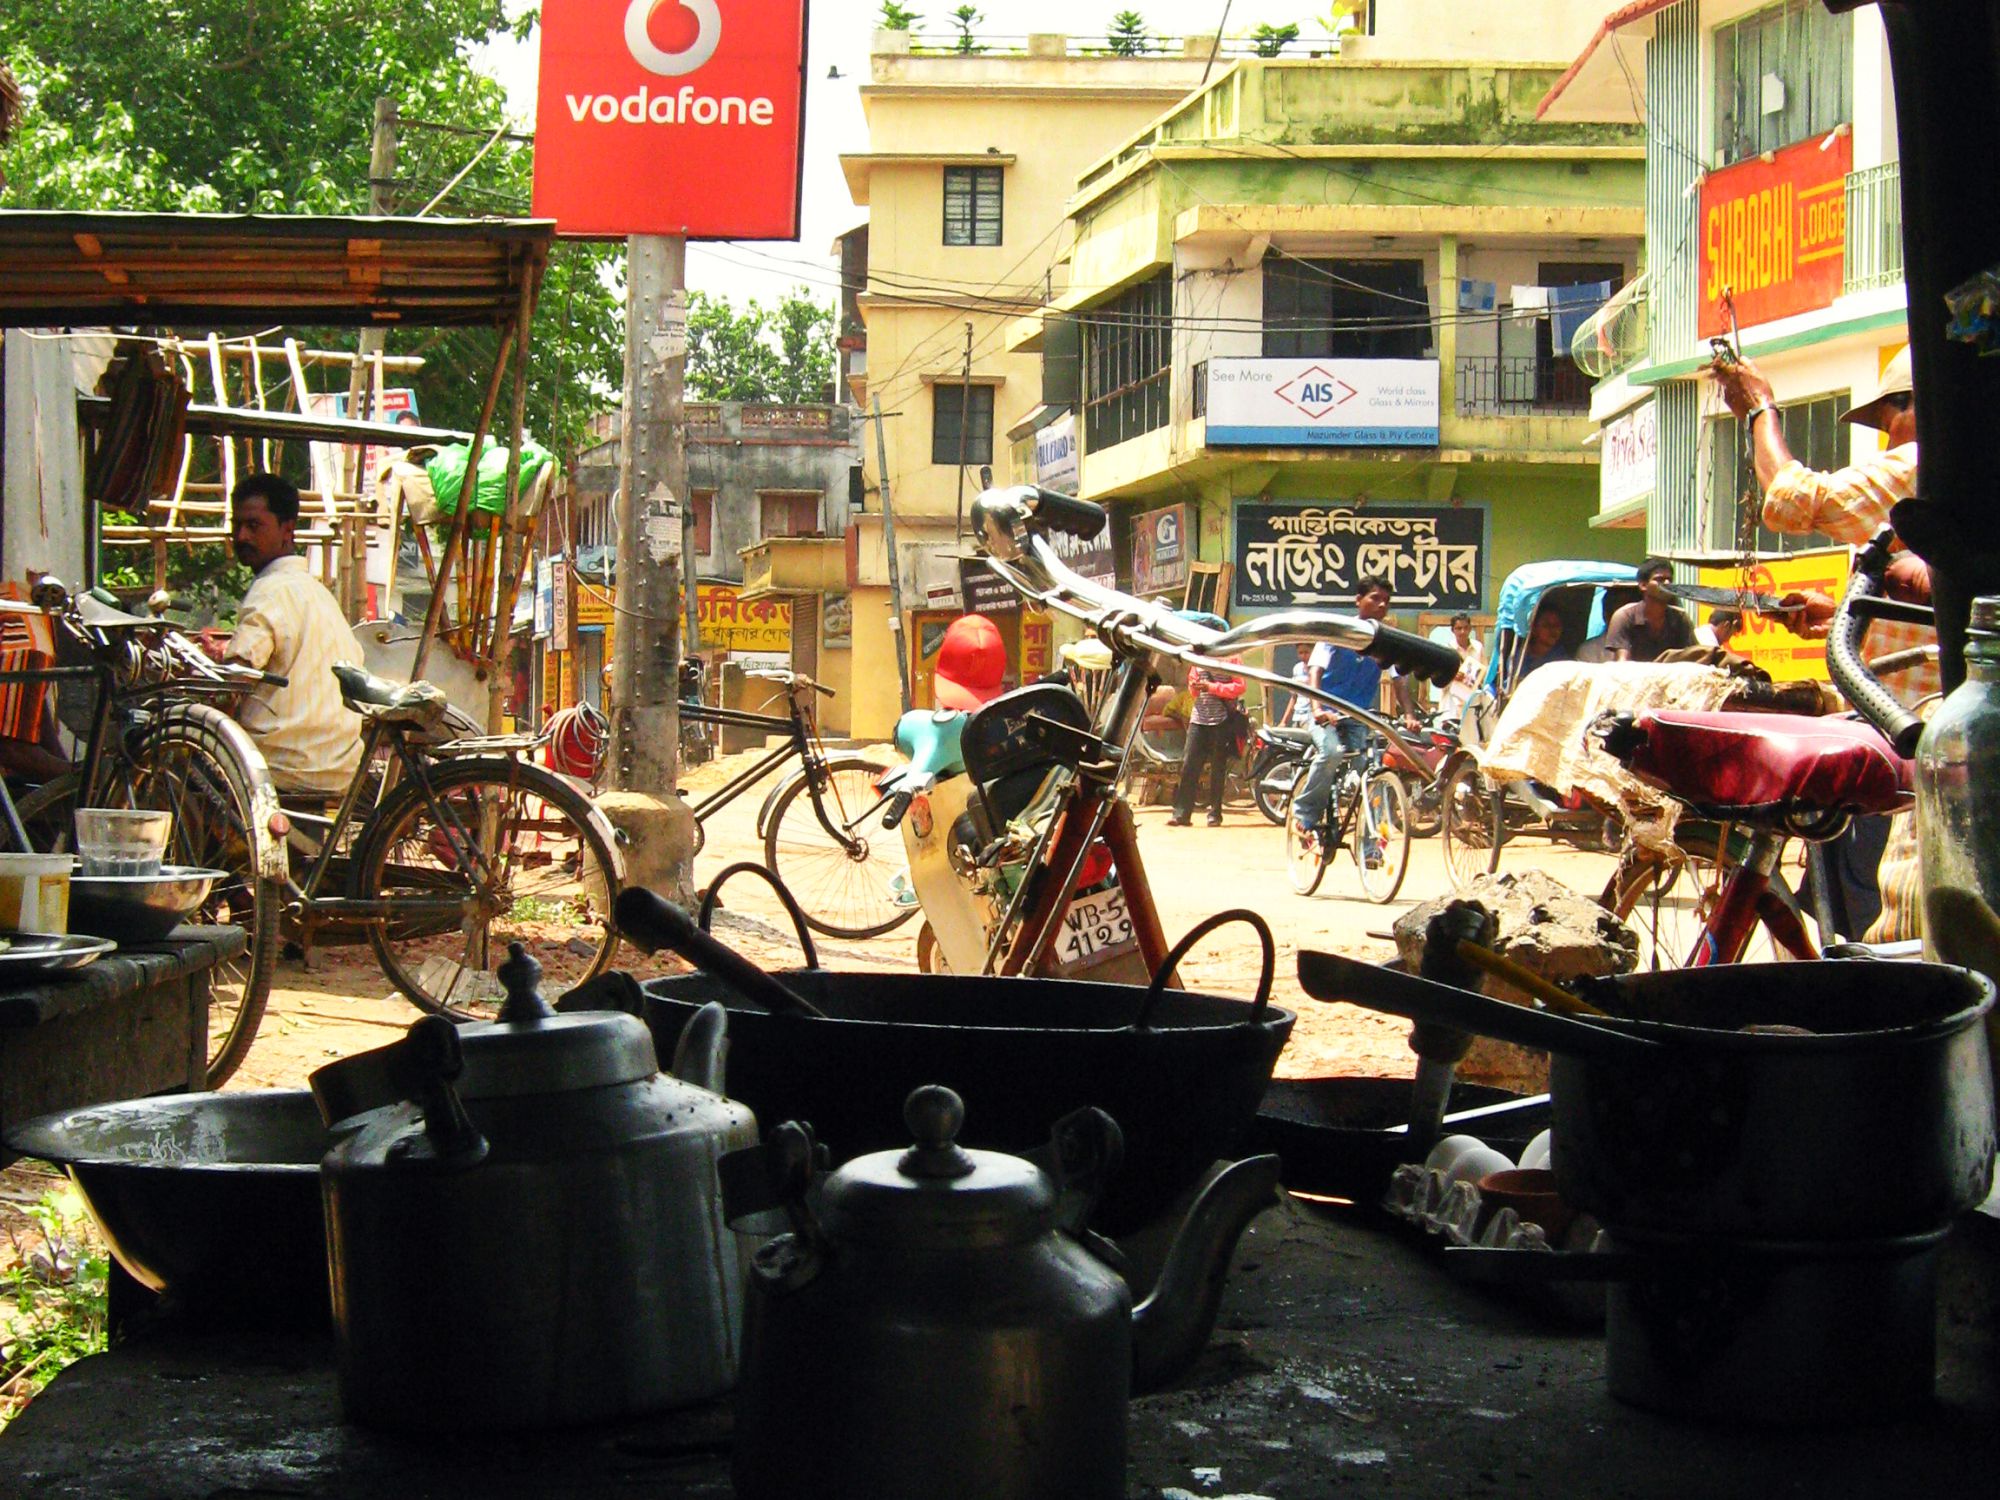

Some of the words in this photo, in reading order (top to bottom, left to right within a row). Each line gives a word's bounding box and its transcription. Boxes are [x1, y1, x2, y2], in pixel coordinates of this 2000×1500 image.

[565, 85, 774, 125] vodafone
[1707, 181, 1793, 302] SURABHI
[1800, 195, 1845, 249] LODGE
[1212, 370, 1235, 382] See
[1239, 370, 1273, 382] More
[1301, 383, 1333, 403] AIS
[1368, 398, 1392, 407] Glass
[1395, 399, 1402, 407] &
[1405, 398, 1435, 407] Mirrors
[1378, 386, 1403, 396] World
[1406, 386, 1426, 396] class
[1307, 430, 1351, 440] Mazumder
[1354, 430, 1377, 440] Glass
[1380, 431, 1386, 440] &
[1404, 430, 1435, 440] Centre
[1268, 508, 1437, 537] শান্তিনিকেতন
[1246, 534, 1350, 591] লজিং
[1356, 535, 1478, 595] সেন্টার
[1064, 890, 1127, 932] WB-5
[1066, 918, 1132, 957] 4129
